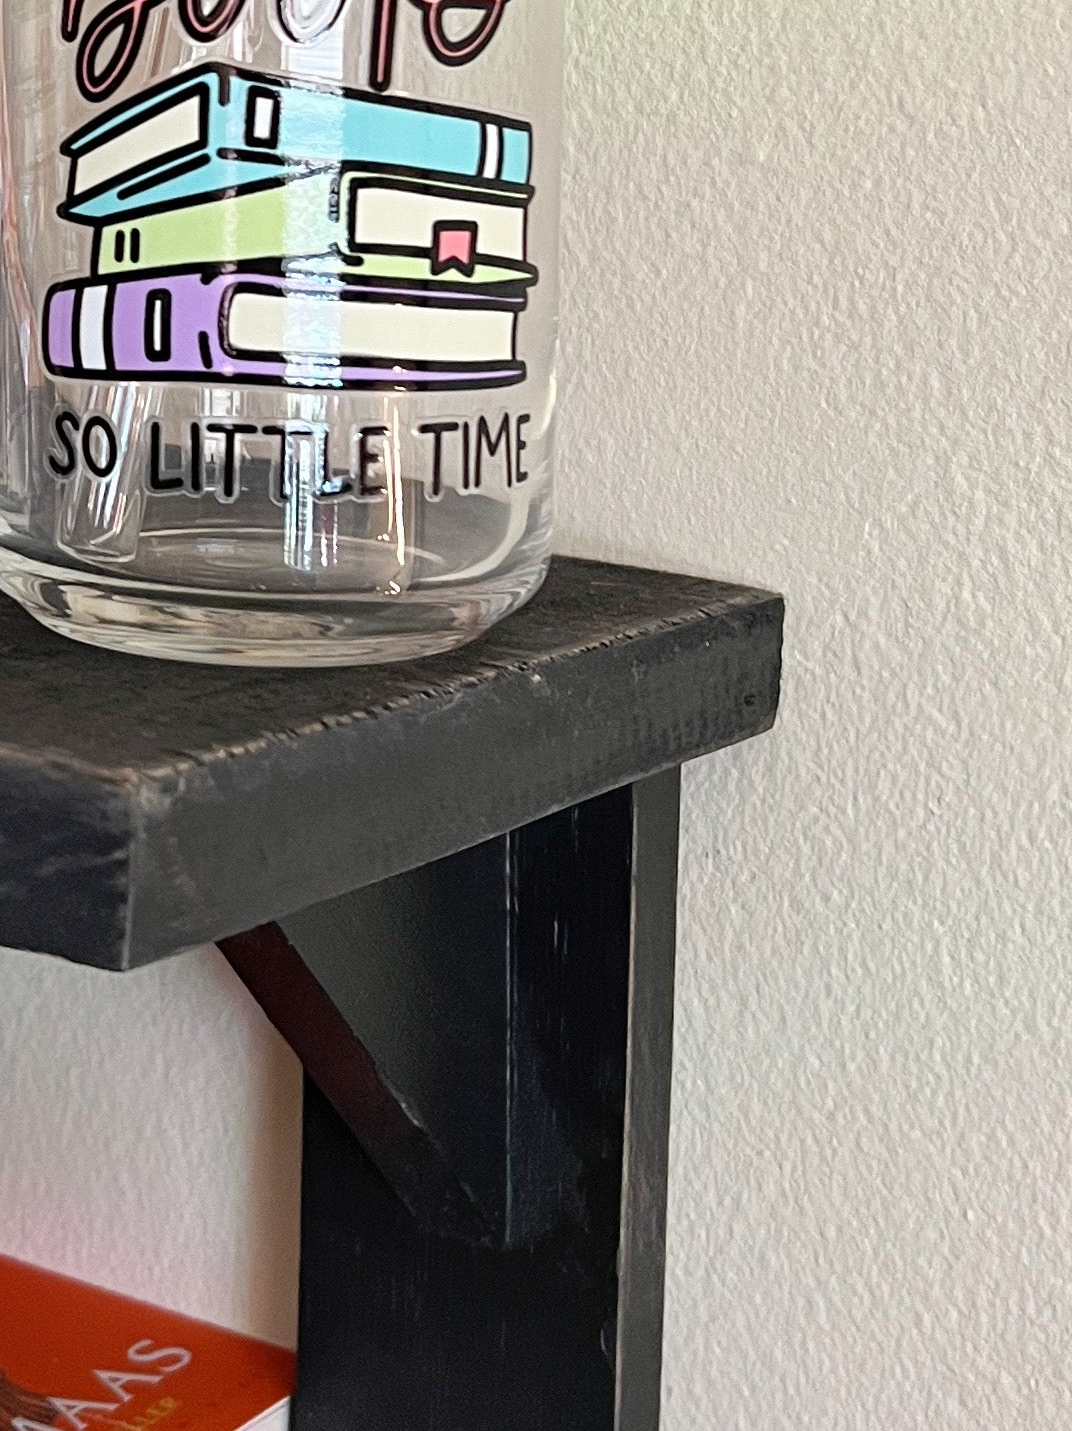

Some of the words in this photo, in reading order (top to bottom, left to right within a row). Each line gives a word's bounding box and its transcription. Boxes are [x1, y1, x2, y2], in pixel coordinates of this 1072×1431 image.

[49, 411, 118, 478] SO
[150, 422, 388, 498] LITTLE
[419, 413, 530, 497] TIME
